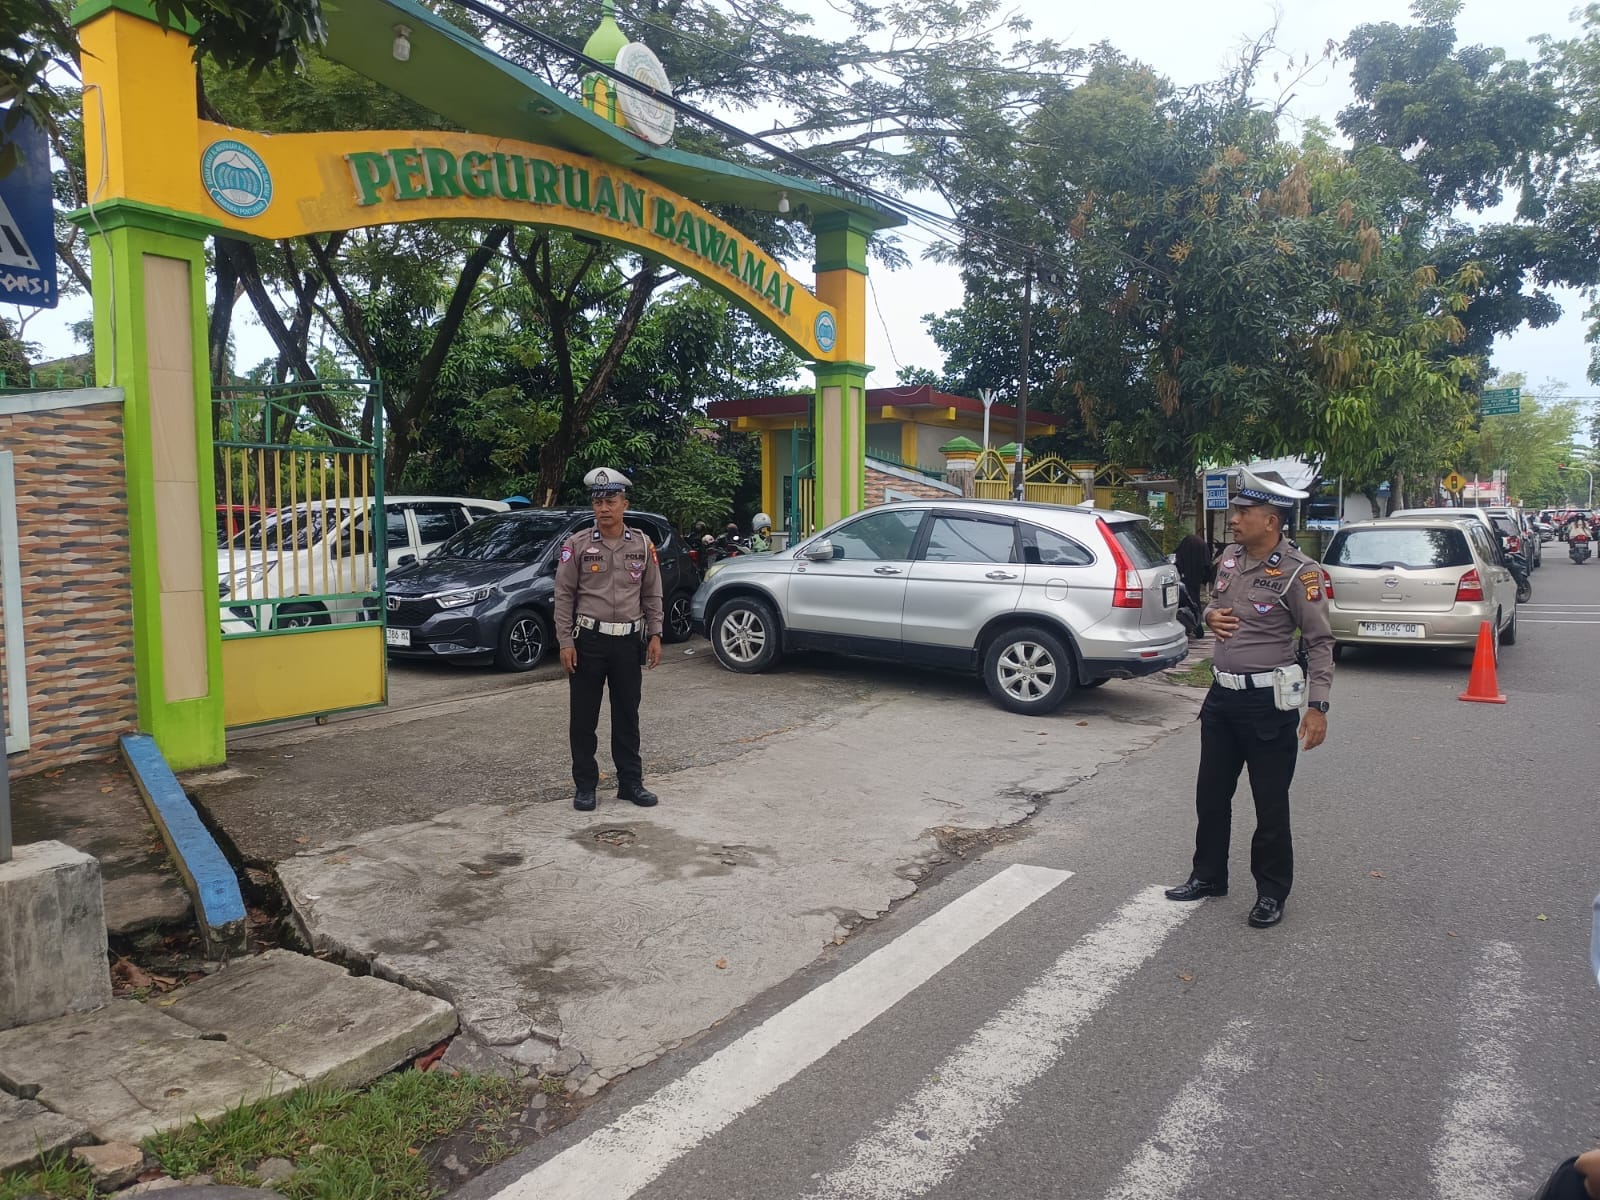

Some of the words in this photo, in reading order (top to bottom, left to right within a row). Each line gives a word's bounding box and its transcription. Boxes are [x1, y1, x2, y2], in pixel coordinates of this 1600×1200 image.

[344, 147, 646, 228] PERGURUAN
[652, 196, 796, 317] BAWAMAI
[583, 554, 604, 562] ERIK
[1253, 578, 1283, 591] POLRI
